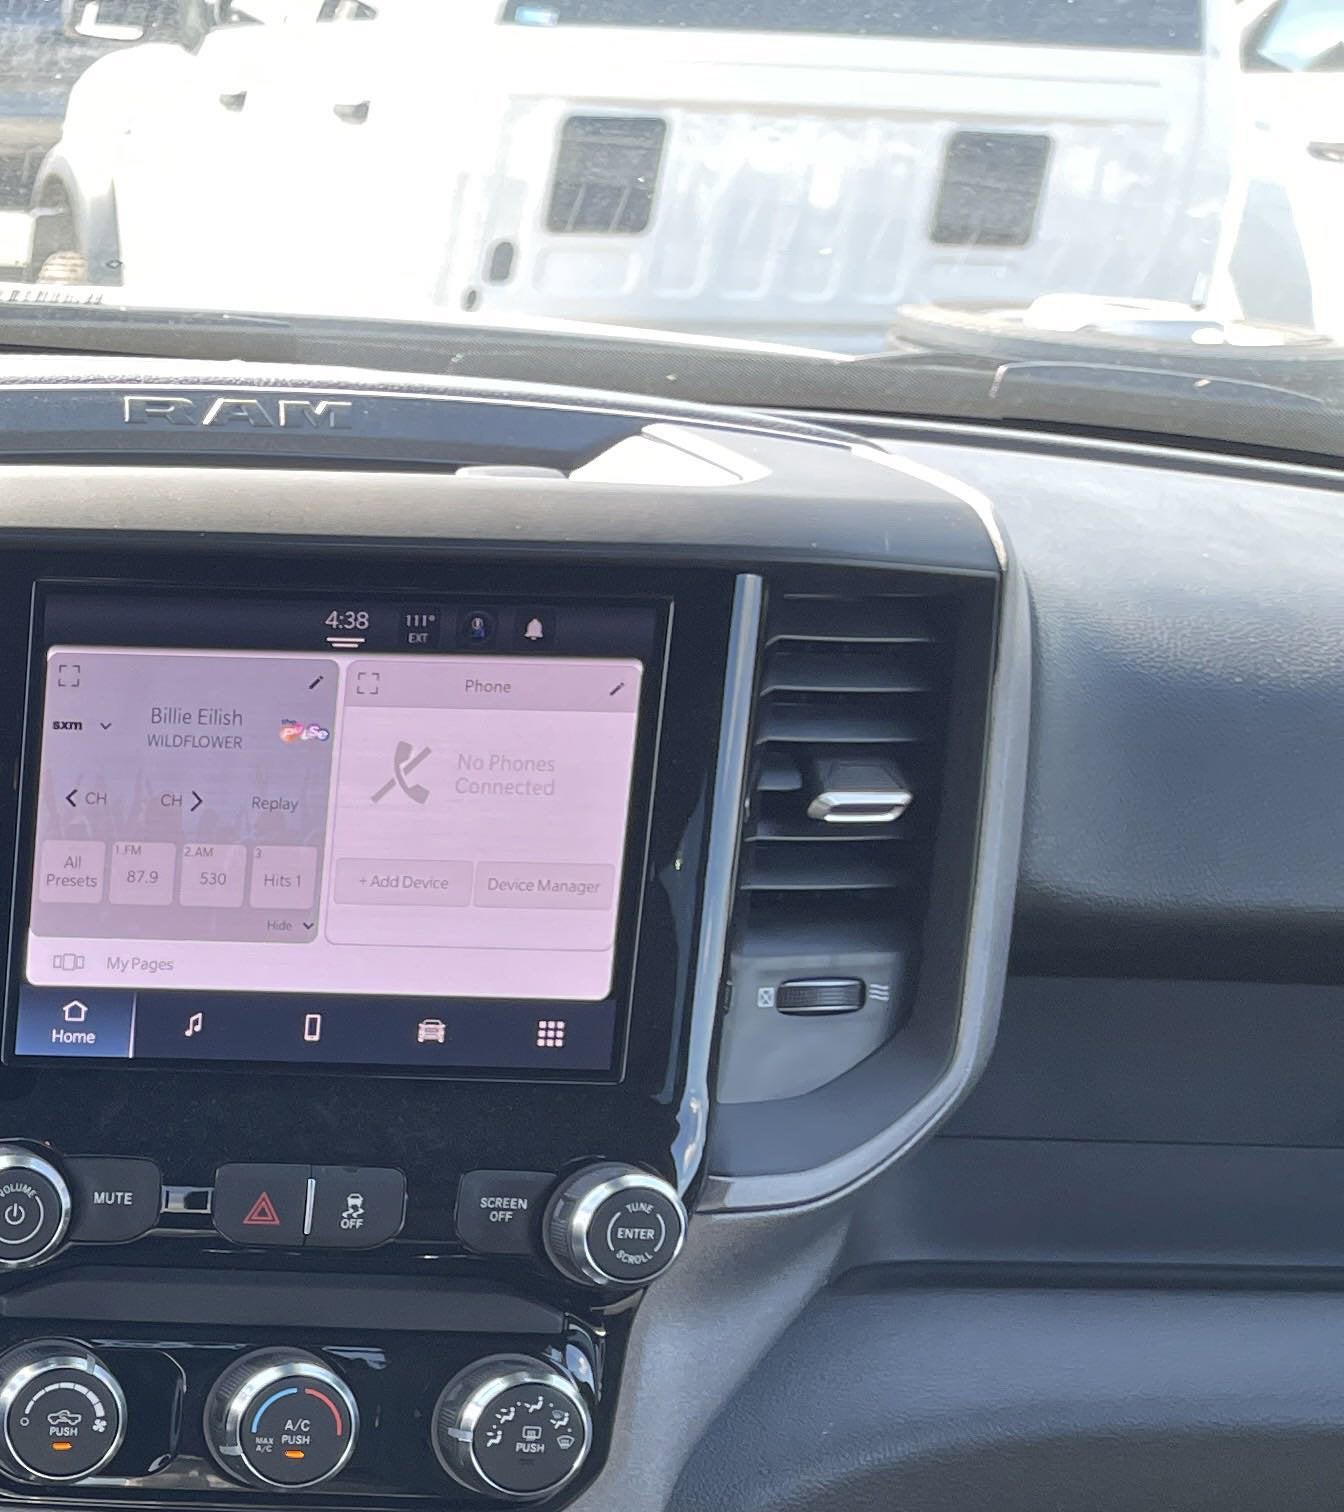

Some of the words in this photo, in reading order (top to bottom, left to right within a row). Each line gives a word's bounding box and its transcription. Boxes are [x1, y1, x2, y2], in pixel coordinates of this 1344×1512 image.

[122, 395, 353, 431] RAM
[325, 611, 369, 629] 4:38
[408, 633, 428, 644] EXT
[465, 680, 512, 693] Phone
[151, 707, 192, 724] Billie
[198, 708, 243, 726] Eilish
[52, 720, 83, 731] sxm
[147, 734, 243, 749] WILDFLOWER
[458, 753, 484, 770] No
[489, 754, 555, 772] Phones
[455, 778, 555, 796] Connected
[85, 792, 107, 805] CH
[161, 794, 182, 807] CH
[252, 796, 298, 813] Replay
[64, 856, 81, 868] All
[46, 874, 97, 888] Presets
[127, 871, 158, 884] 87.9
[199, 872, 226, 885] 530
[264, 874, 292, 888] Hits
[295, 875, 302, 888] 1
[369, 875, 399, 889] Add
[402, 876, 449, 889] Device
[488, 878, 534, 892] Device
[537, 880, 600, 895] Manager
[266, 921, 292, 931] Hide
[106, 956, 129, 972] My
[131, 957, 174, 972] Pages
[51, 1028, 96, 1045] Home
[94, 1191, 132, 1205] MUTE
[480, 1198, 527, 1210] SCREEN
[626, 1203, 654, 1214] TUNE
[489, 1211, 513, 1222] OFF
[341, 1218, 364, 1229] OFF
[617, 1228, 655, 1240] ENTER
[616, 1250, 654, 1265] SCROLL
[50, 1425, 78, 1437] PUSH
[285, 1418, 311, 1432] A/C
[256, 1437, 274, 1445] MAX
[282, 1434, 311, 1445] PUSH
[255, 1445, 273, 1453] A/C
[516, 1442, 545, 1453] PUSH
